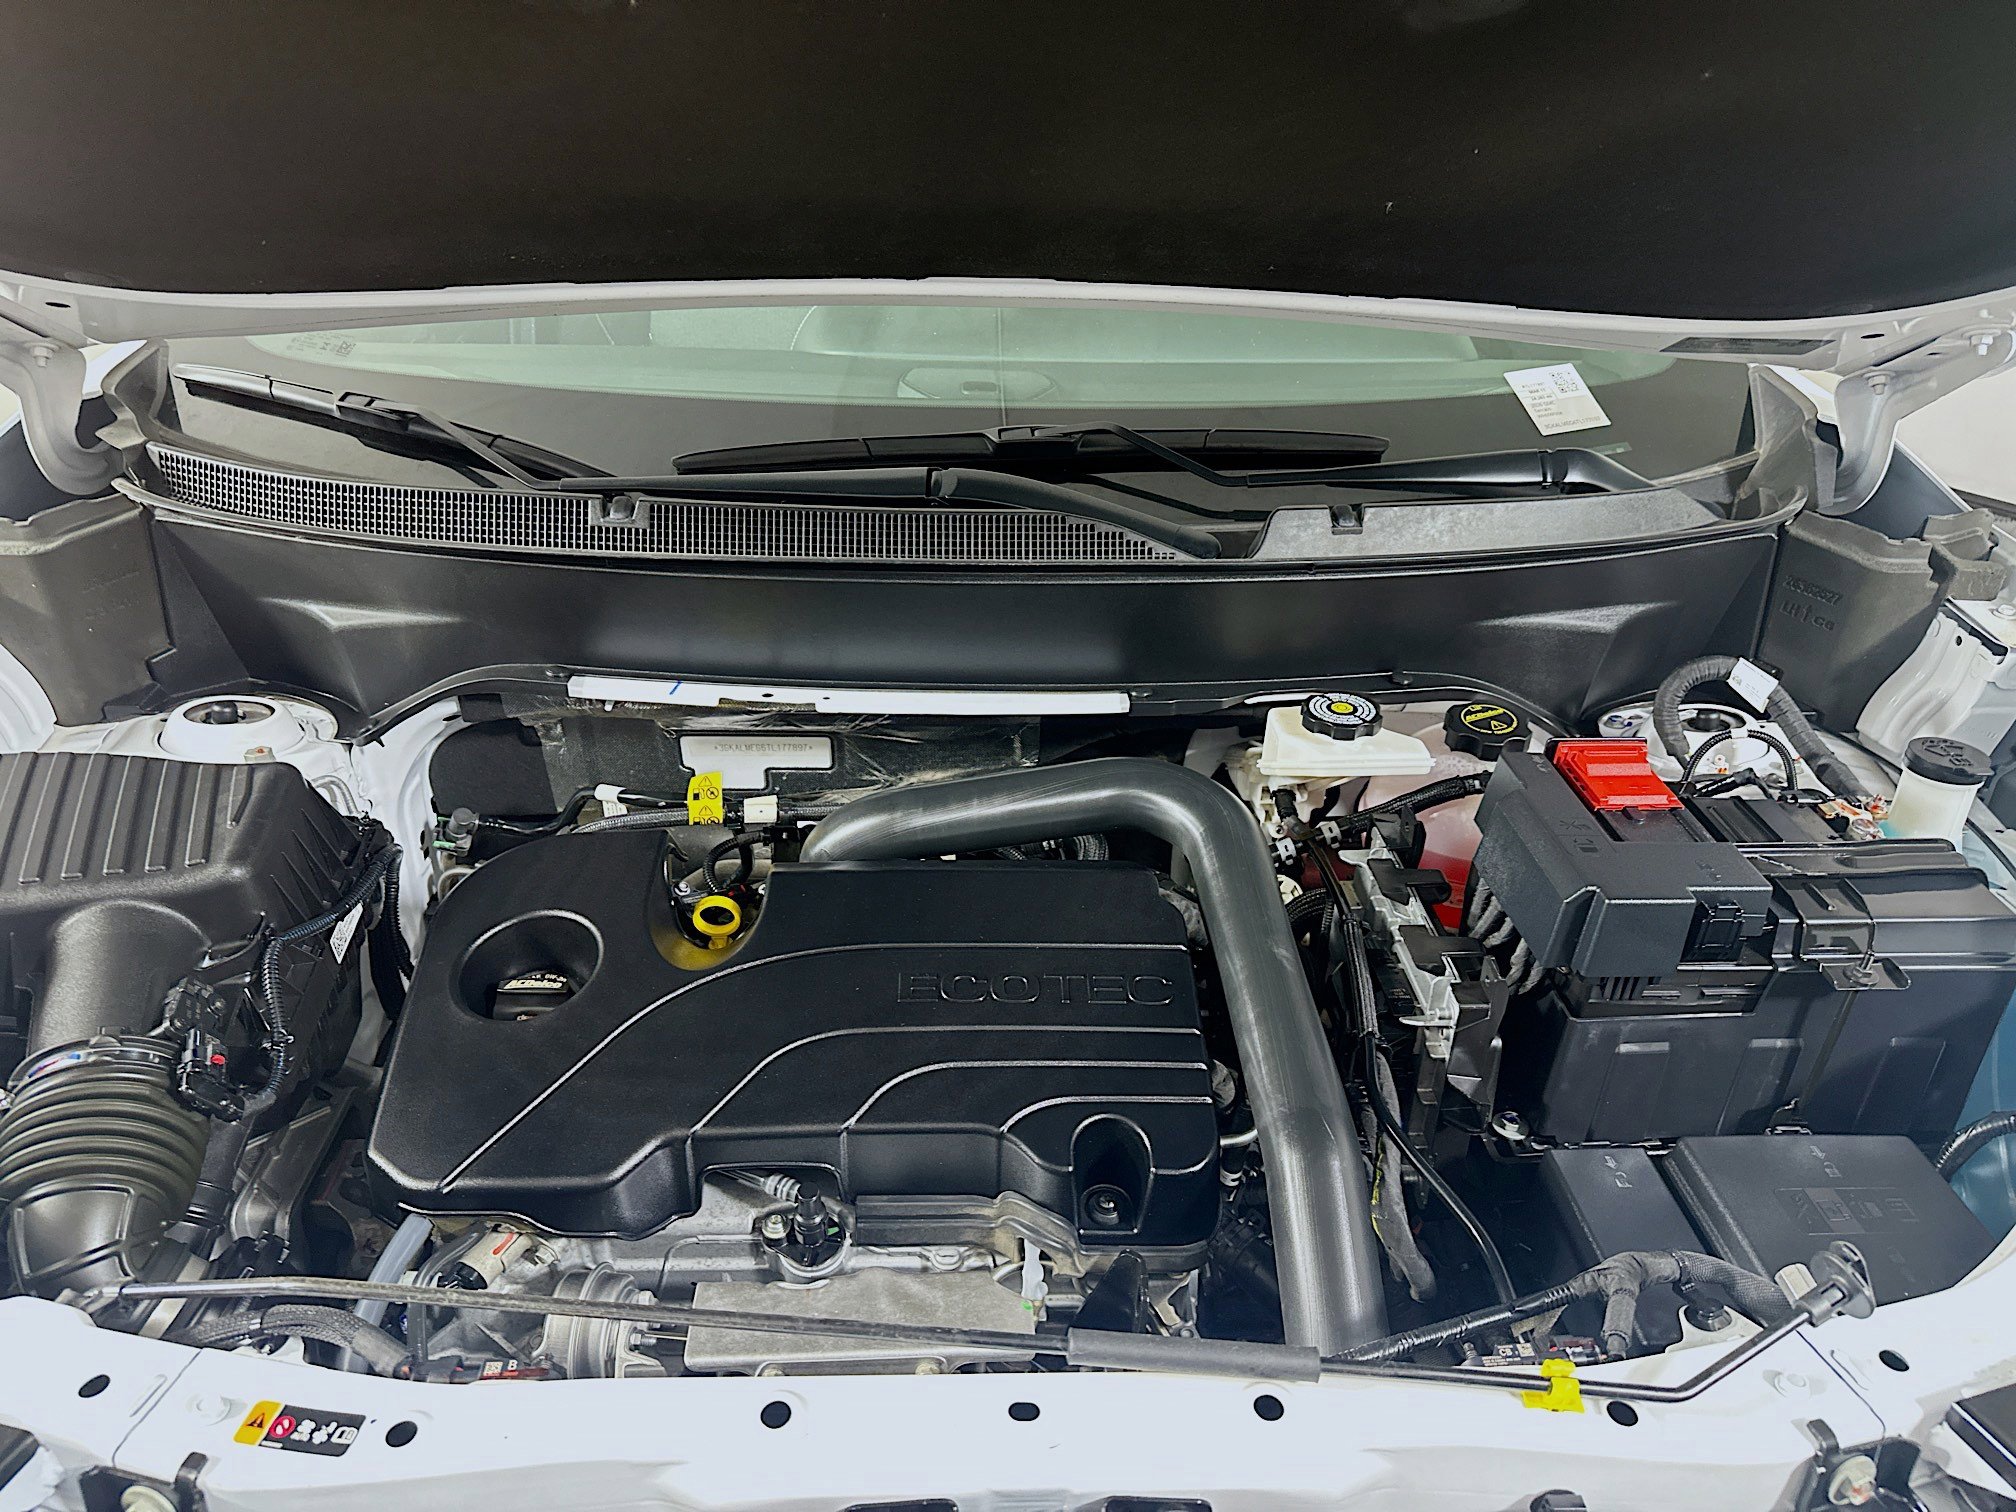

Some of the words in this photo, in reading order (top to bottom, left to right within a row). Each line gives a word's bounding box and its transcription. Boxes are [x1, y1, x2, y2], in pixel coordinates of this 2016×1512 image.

[503, 979, 563, 990] ACDelco
[897, 972, 1173, 1006] ECOTEC
[507, 1359, 518, 1371] B
